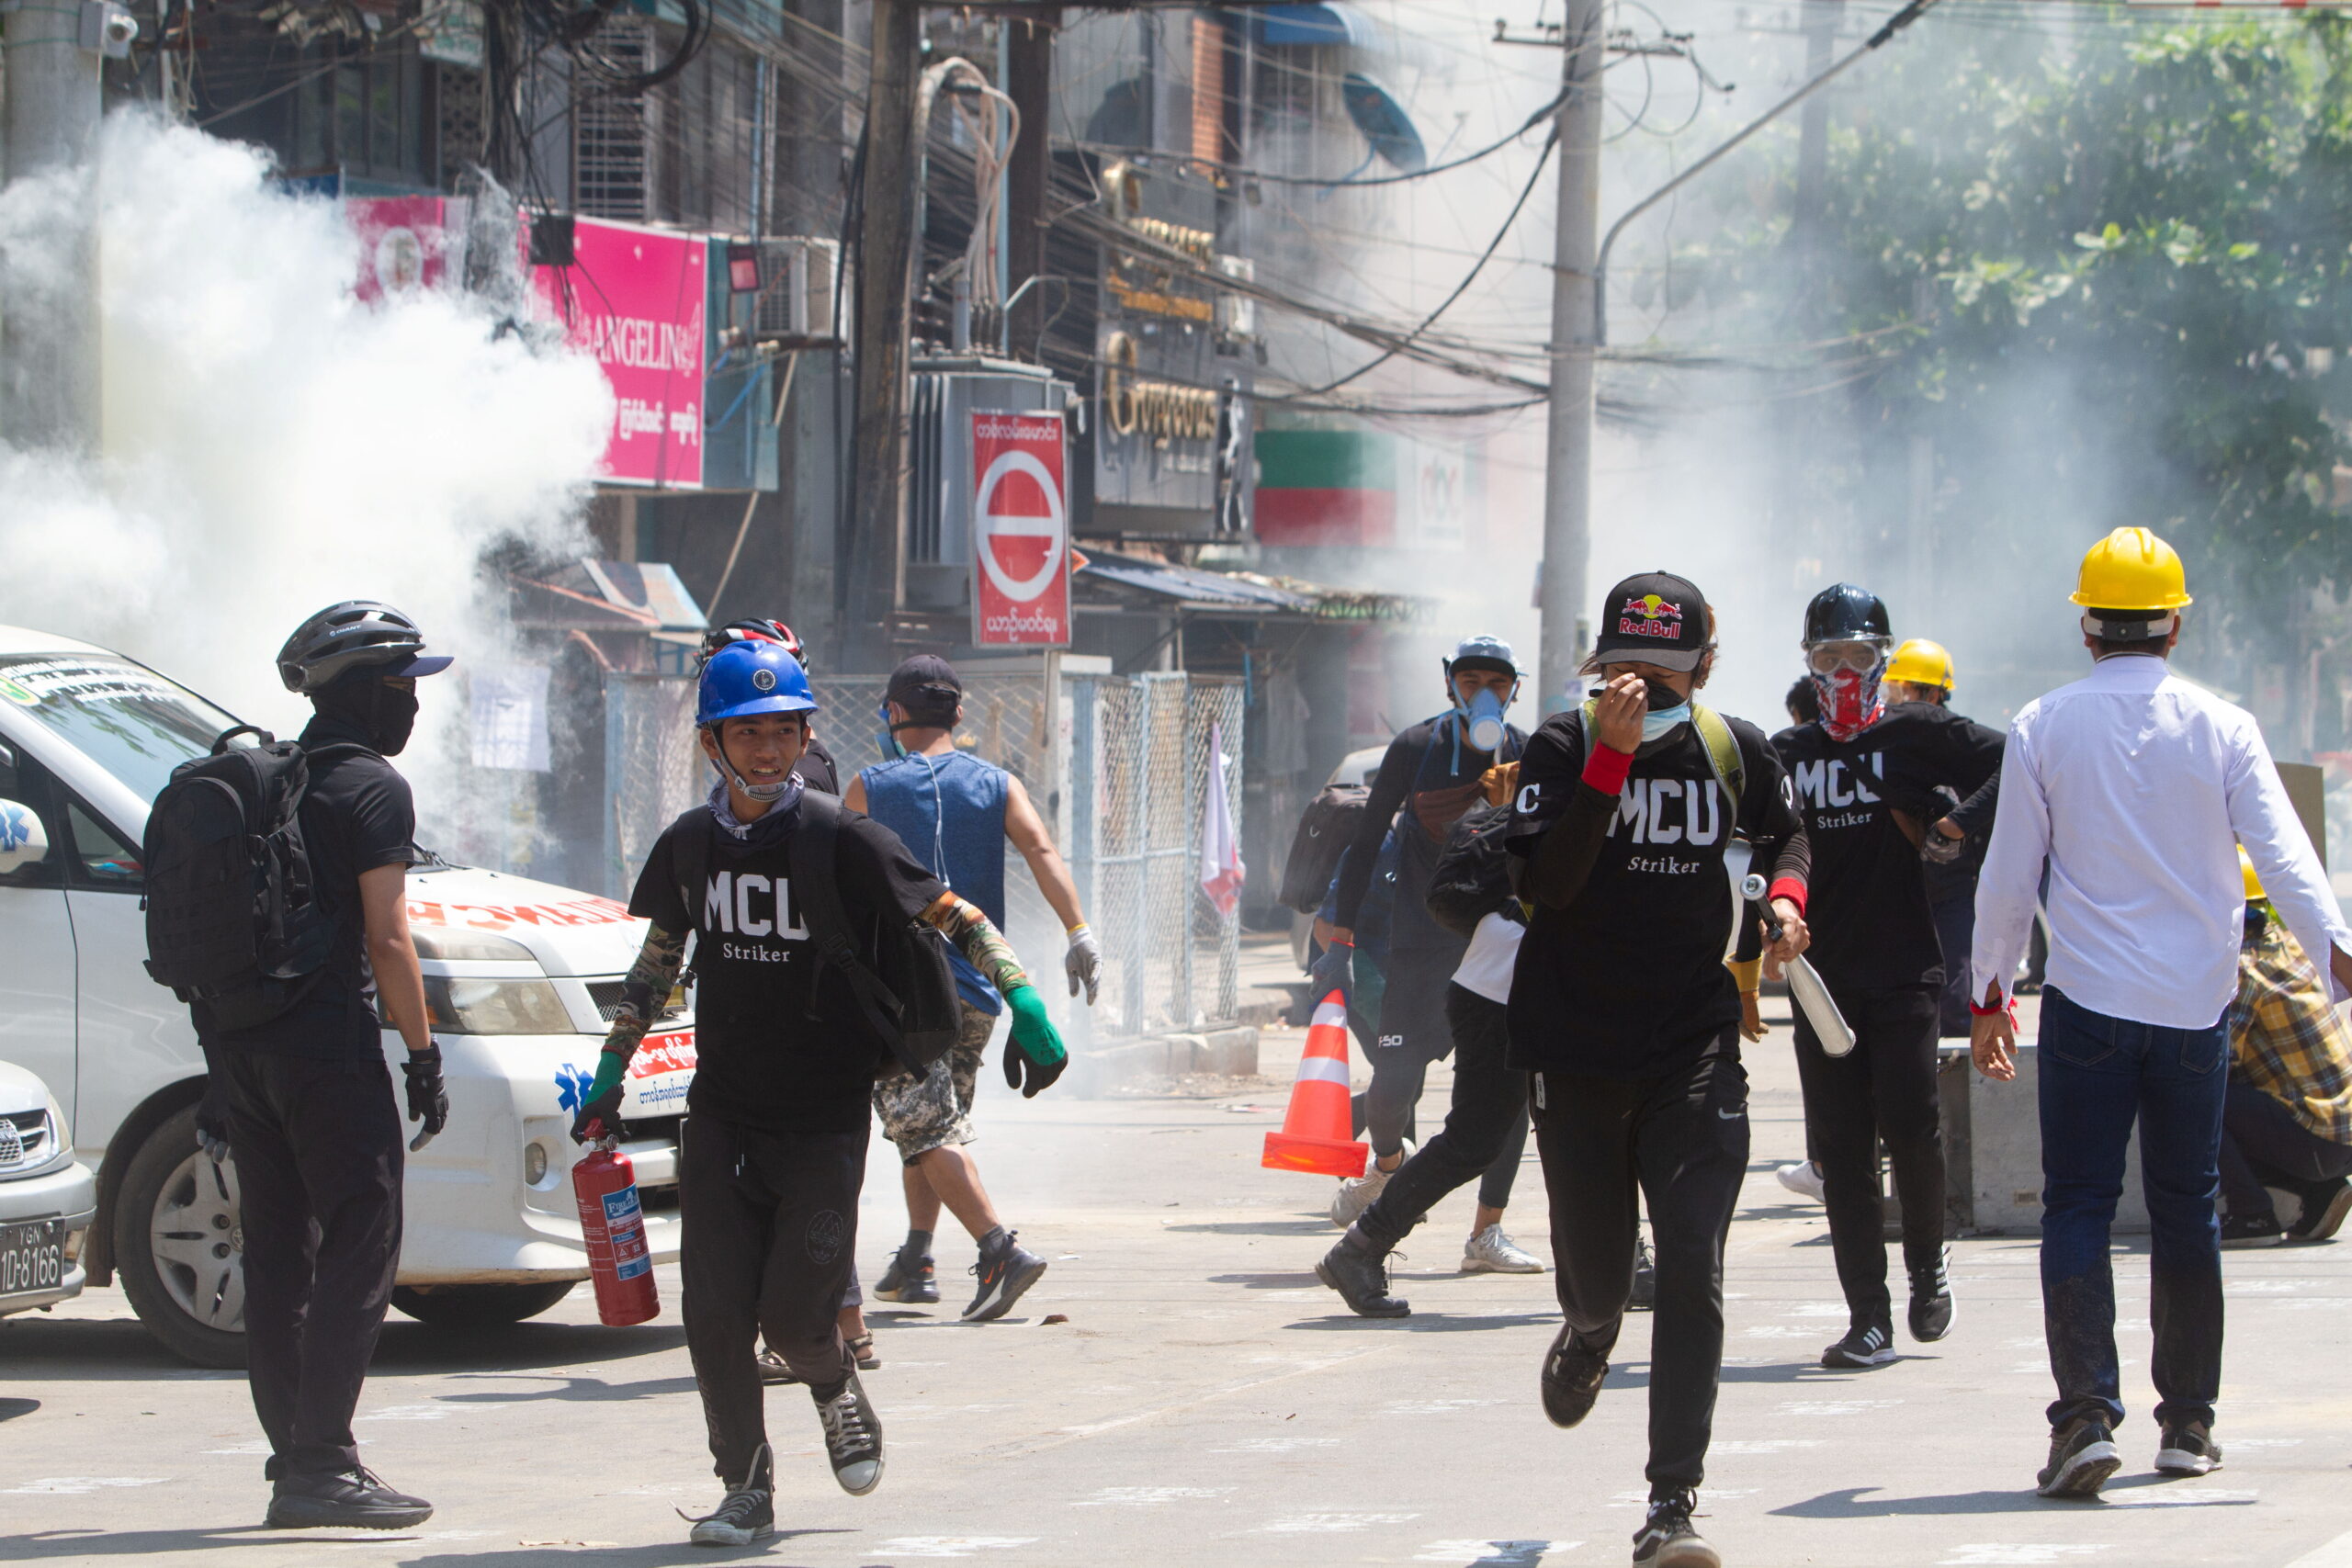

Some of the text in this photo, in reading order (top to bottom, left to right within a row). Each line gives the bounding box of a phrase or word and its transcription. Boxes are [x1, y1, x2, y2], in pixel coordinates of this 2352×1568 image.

[1619, 617, 1680, 639] Red Bull
[1606, 778, 1720, 846] MCU
[1817, 812, 1872, 829] Striker
[1628, 856, 1700, 874] Striker
[723, 942, 790, 963] Striker
[19, 1226, 41, 1246] YGN
[1, 1245, 59, 1292] 1D-8166
